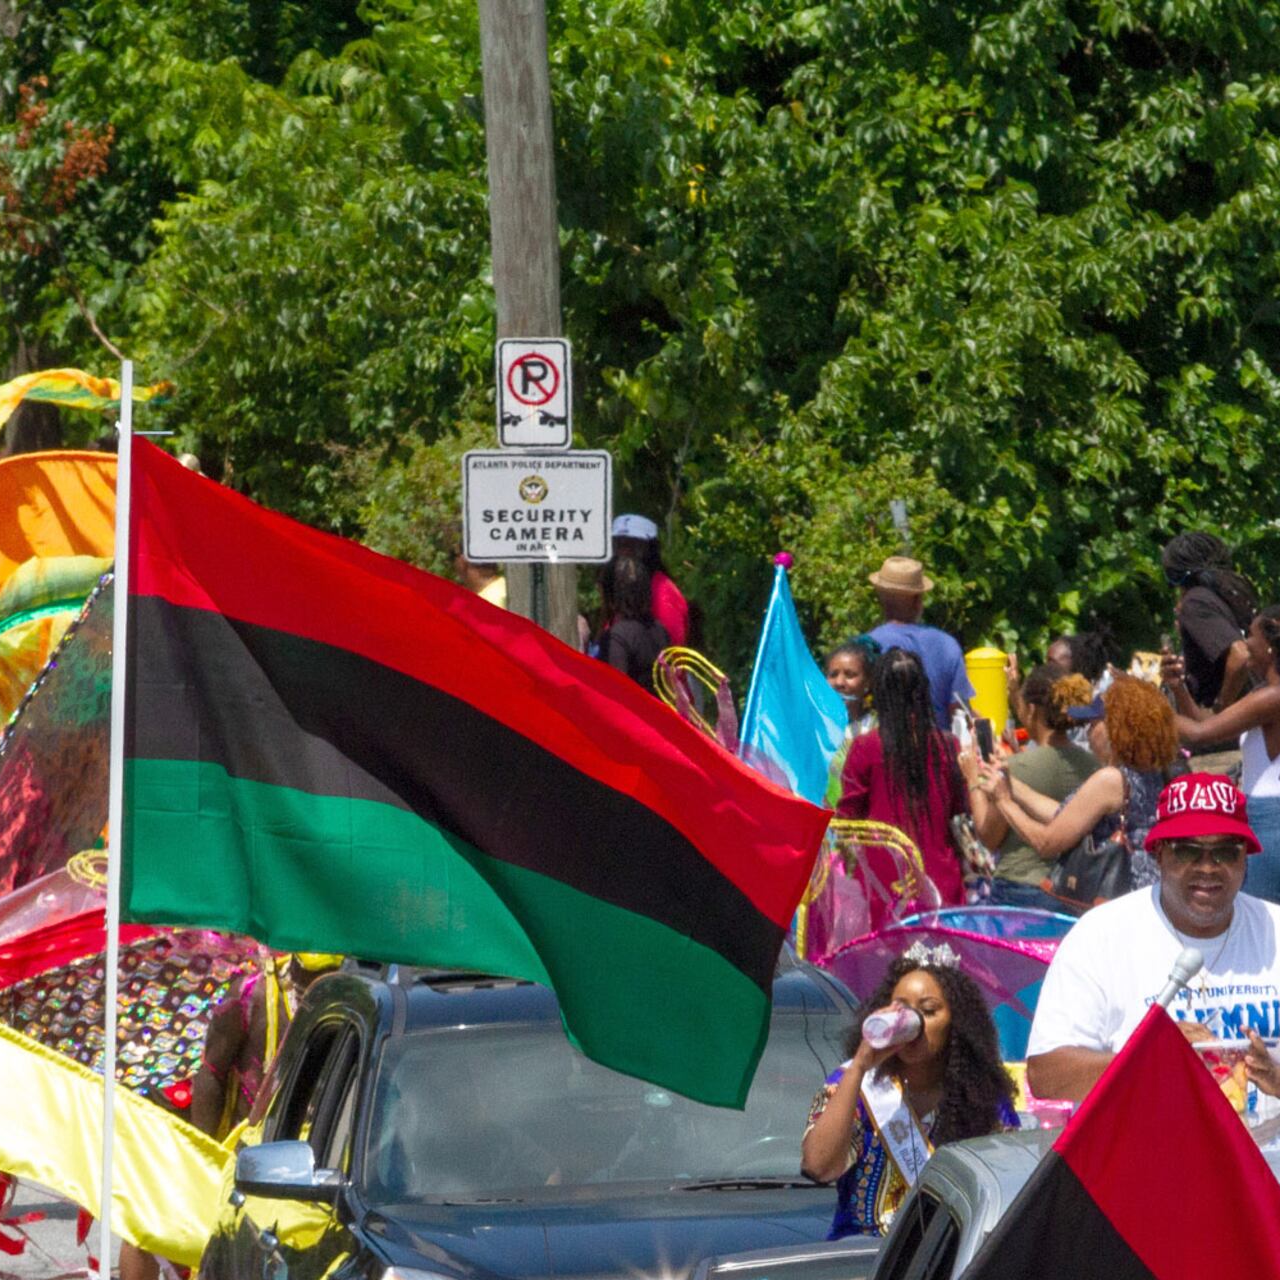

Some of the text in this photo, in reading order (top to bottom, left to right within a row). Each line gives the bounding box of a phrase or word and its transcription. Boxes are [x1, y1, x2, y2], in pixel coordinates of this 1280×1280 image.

[471, 460, 601, 469] ATLANTA POLICE DEPARTMENT
[482, 509, 592, 523] SECURITY
[489, 527, 584, 541] CAMERA
[516, 543, 528, 551] IN
